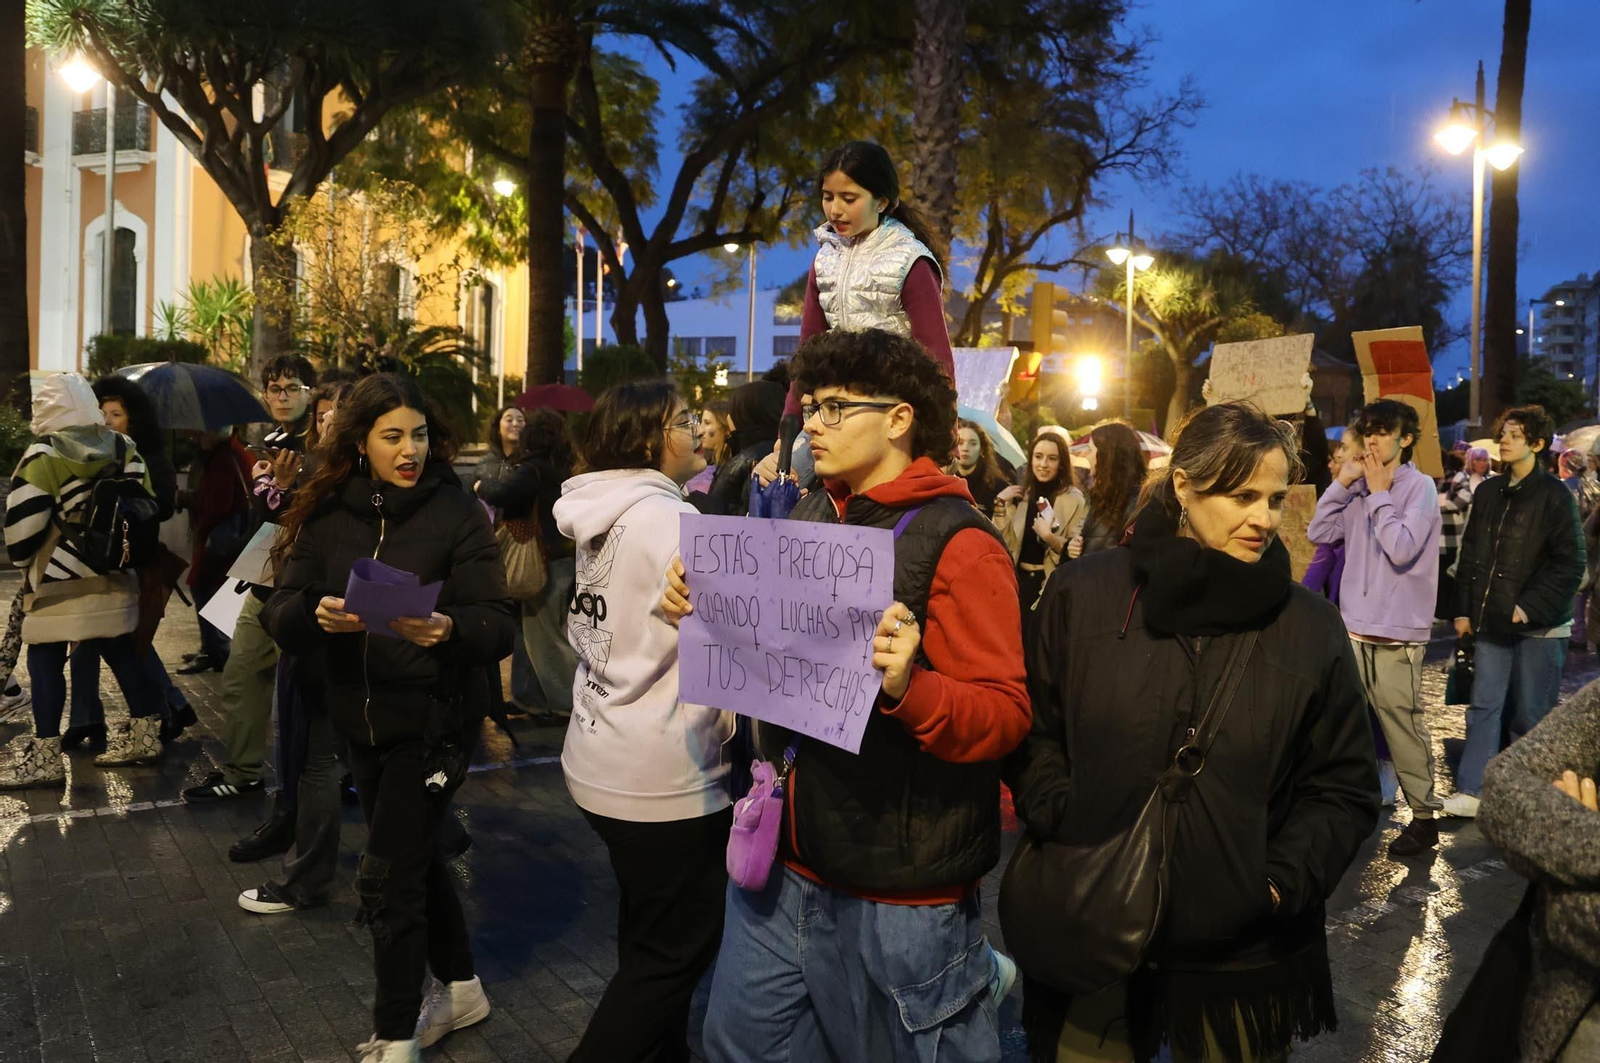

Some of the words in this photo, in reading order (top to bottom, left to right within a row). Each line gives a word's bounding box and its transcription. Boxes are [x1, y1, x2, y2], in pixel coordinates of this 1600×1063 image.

[692, 530, 758, 575] ESTÁS
[778, 535, 874, 602] PRECIOSA
[697, 592, 760, 650] CUANDO
[781, 599, 840, 638] LUCHAS
[703, 644, 747, 690] TUS
[766, 652, 871, 739] DERECHOS
